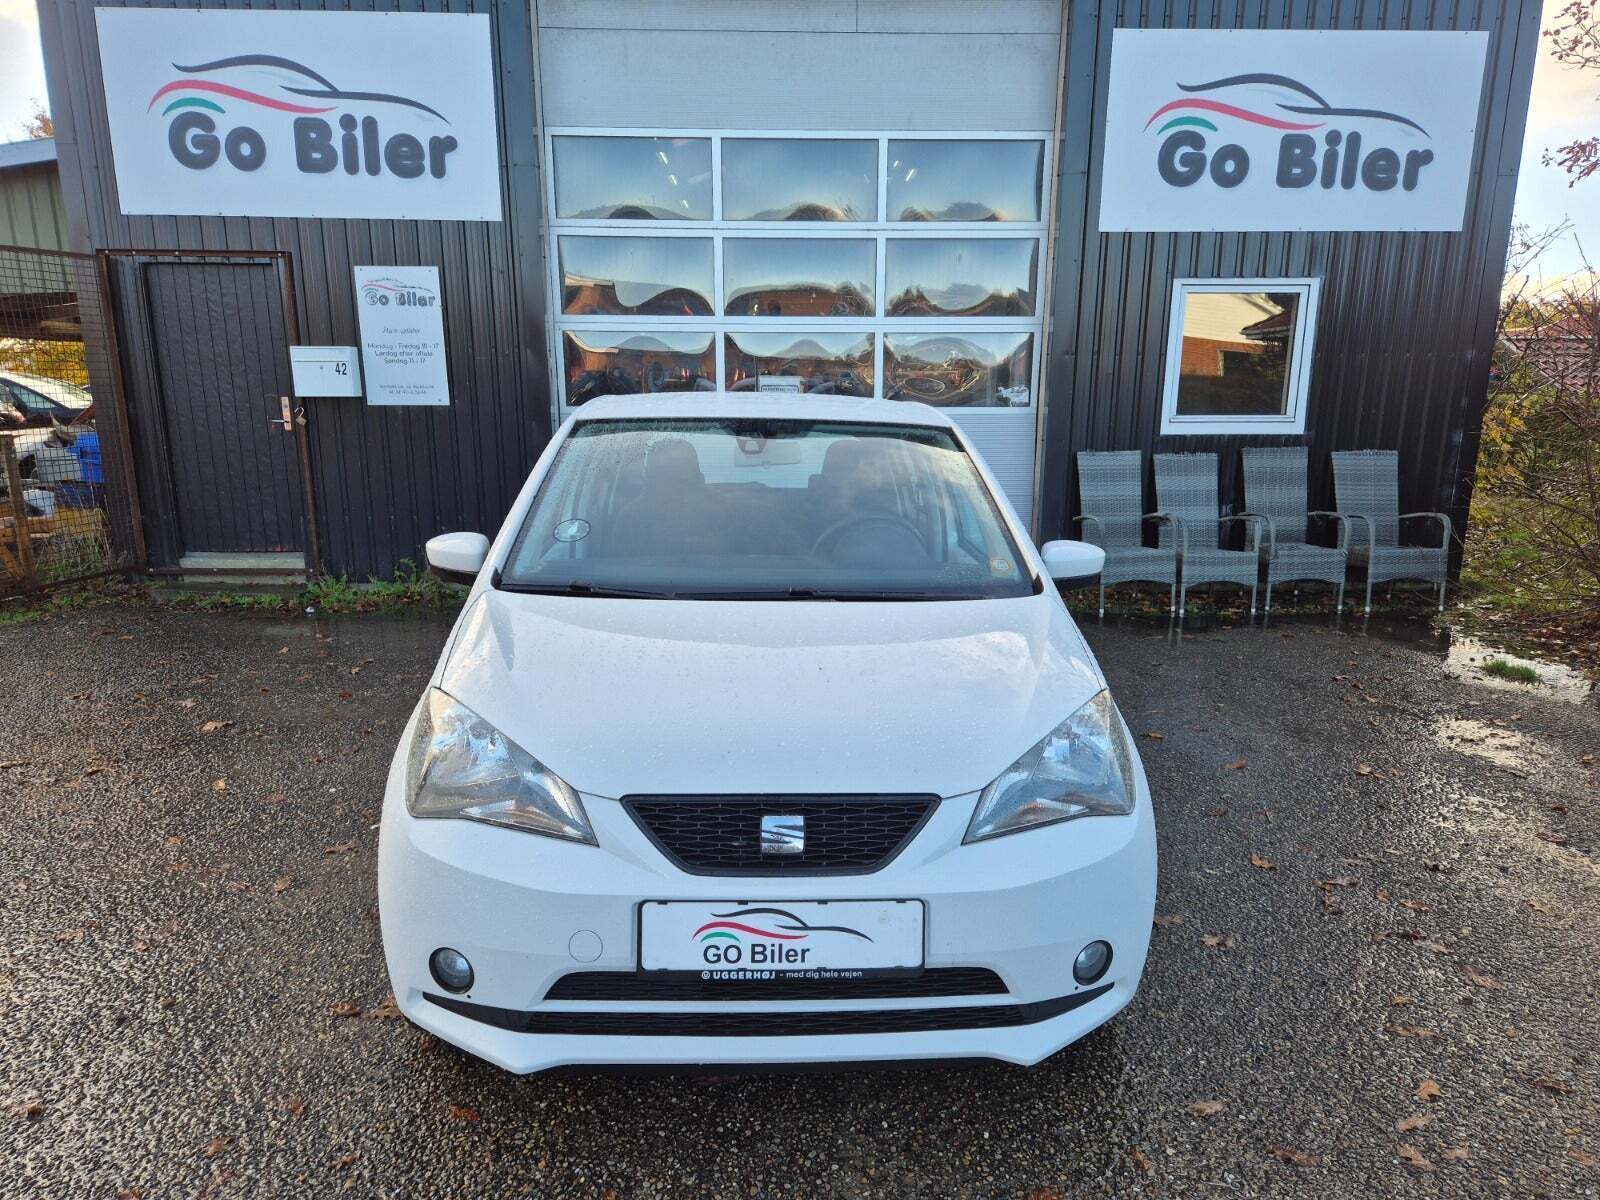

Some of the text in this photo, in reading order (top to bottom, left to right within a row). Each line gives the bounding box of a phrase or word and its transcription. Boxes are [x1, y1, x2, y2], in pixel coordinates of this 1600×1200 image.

[168, 111, 458, 179] Go Biler
[1157, 129, 1434, 191] Go Biler
[365, 290, 436, 307] Go Biler
[398, 342, 421, 351] Fredag
[335, 362, 347, 375] 42
[703, 943, 811, 964] GO Biler
[713, 970, 775, 980] UGGERHØJ
[786, 970, 804, 979] med
[806, 970, 819, 980] dig
[821, 970, 838, 978] hele
[840, 970, 862, 980] vejen
